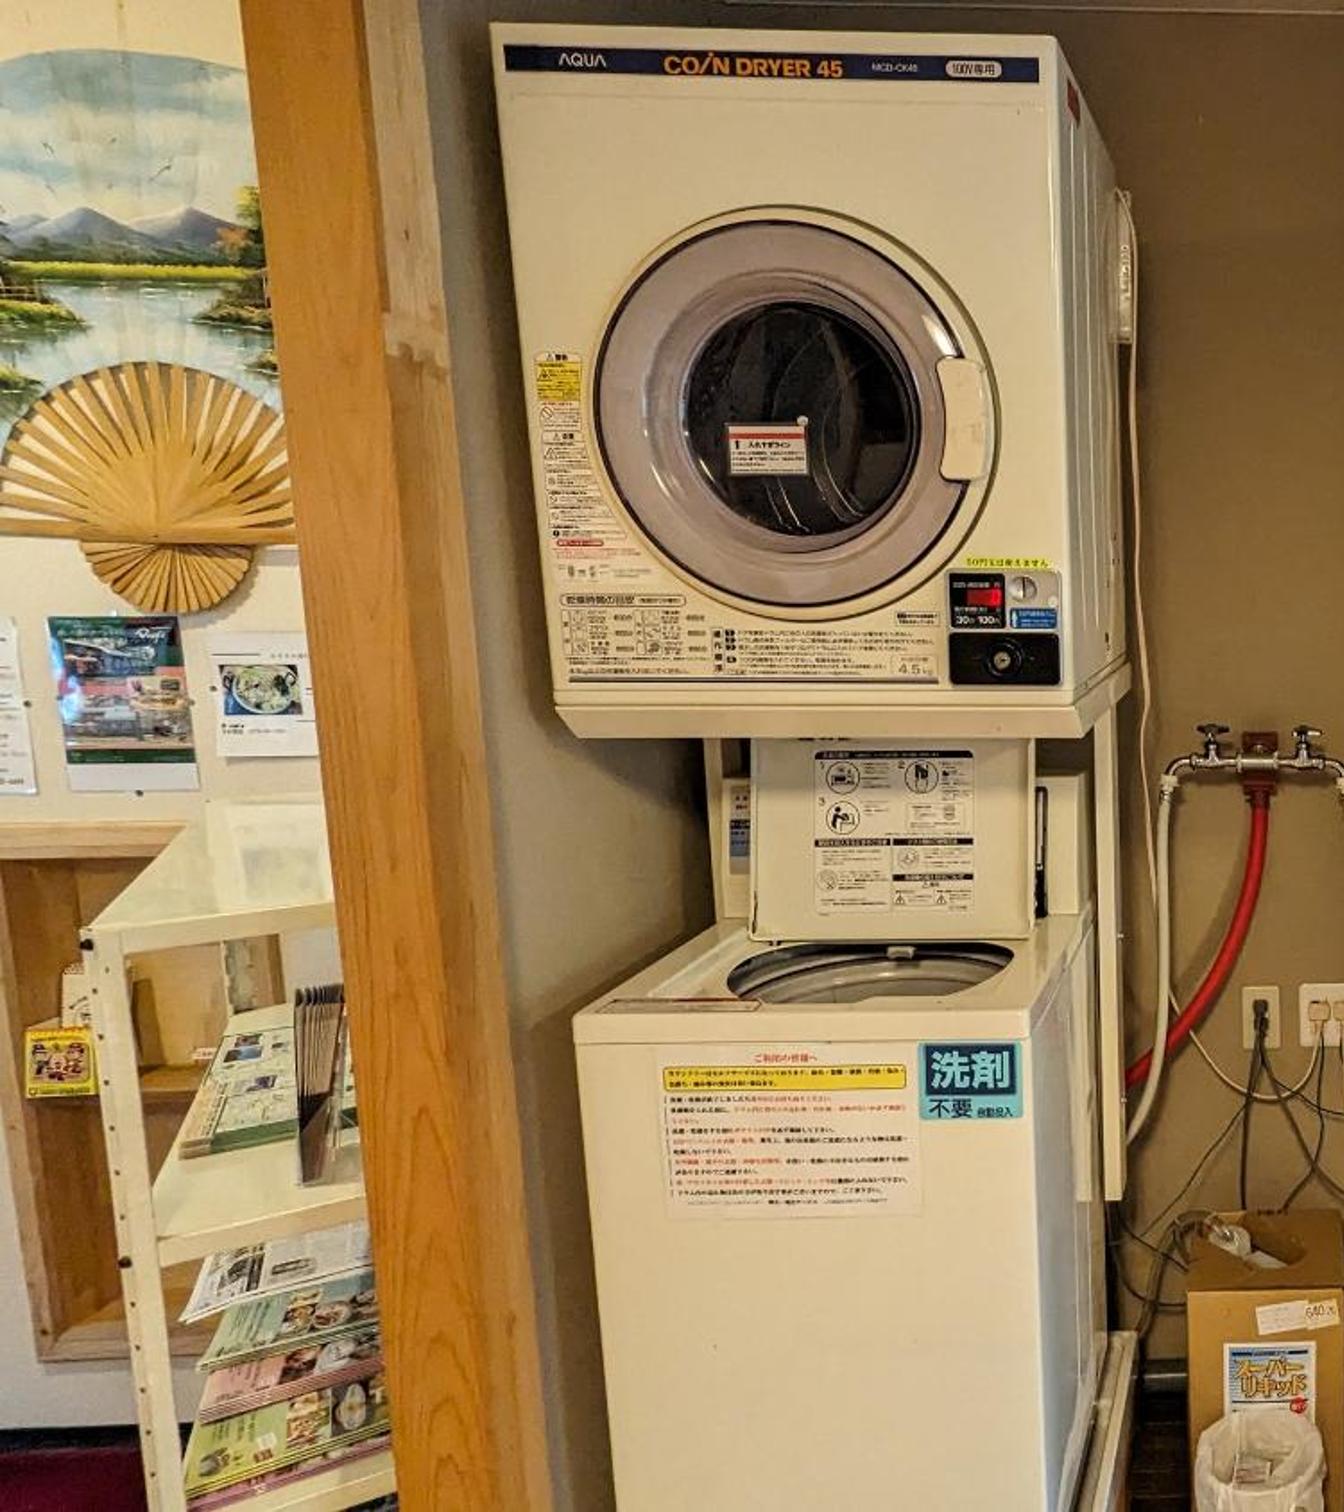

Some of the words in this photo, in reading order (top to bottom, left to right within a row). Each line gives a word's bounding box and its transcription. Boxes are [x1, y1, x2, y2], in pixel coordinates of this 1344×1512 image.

[558, 52, 607, 68] AQUA
[663, 52, 730, 75] COIN
[735, 57, 812, 77] DRYER
[816, 59, 844, 78] 45
[930, 1051, 1010, 1088] 洗剤
[928, 1098, 973, 1118] 不要
[1235, 1356, 1305, 1378] スーパー
[1240, 1374, 1308, 1399] リキッド
